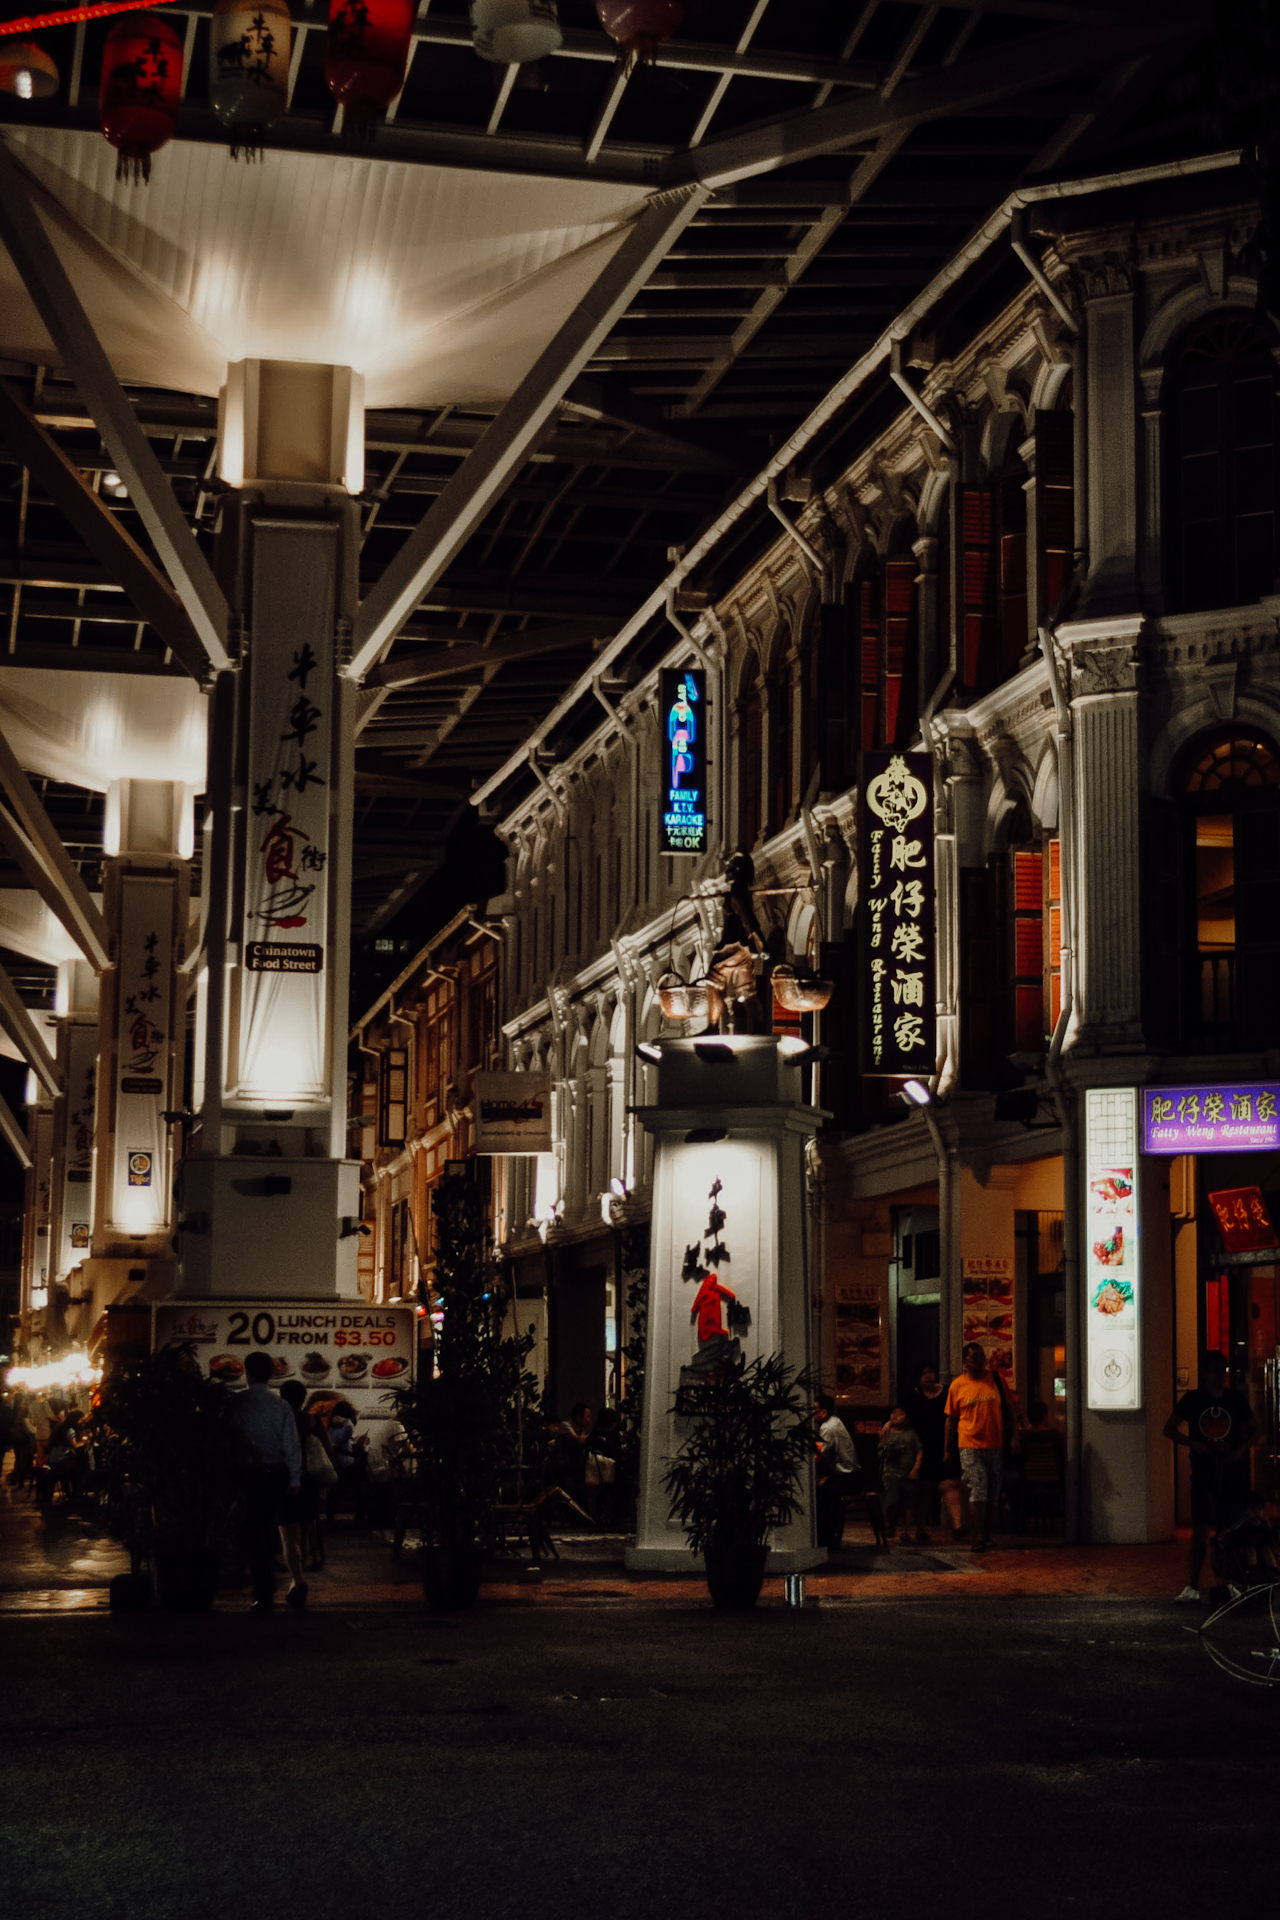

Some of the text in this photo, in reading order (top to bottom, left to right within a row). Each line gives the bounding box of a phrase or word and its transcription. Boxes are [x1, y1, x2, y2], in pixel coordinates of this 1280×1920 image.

[669, 789, 699, 801] FAMILY
[664, 813, 703, 826] KARAOKE
[252, 944, 316, 957] Chinatown
[868, 829, 888, 1065] Fatty Weng Restaurant
[889, 834, 928, 1052] 肥仔榮酒家
[251, 957, 316, 970] Food Street
[1150, 1090, 1278, 1124] 肥仔榮酒家
[1150, 1123, 1278, 1142] Fatty Weng Restaurant
[227, 1311, 275, 1345] 20
[278, 1315, 336, 1328] LUNCH
[341, 1316, 396, 1329] DEALS
[276, 1329, 396, 1348] FROM $3.50
